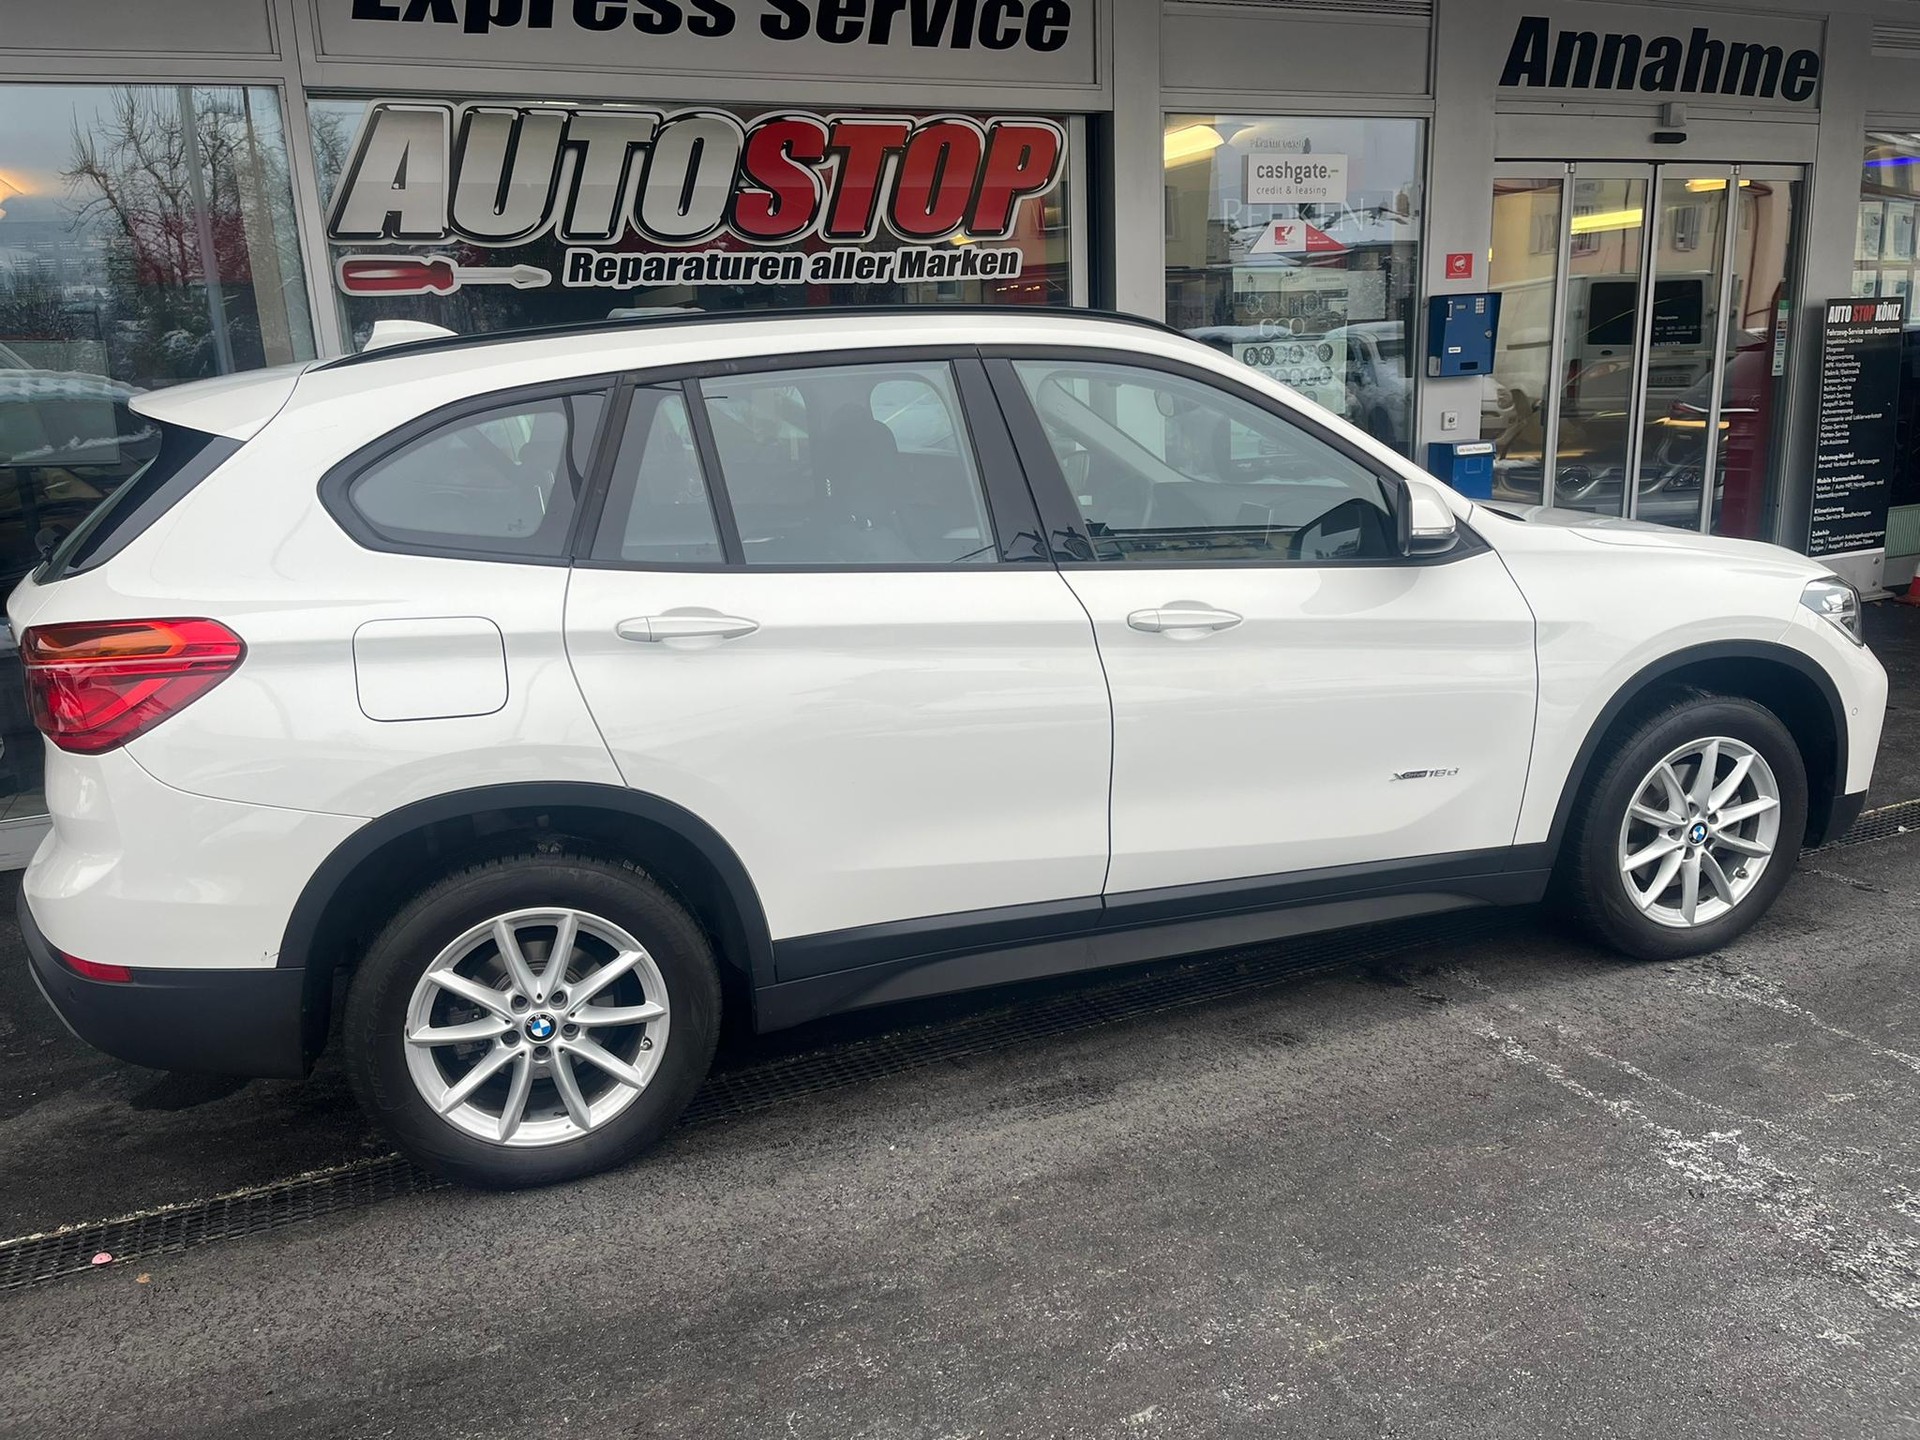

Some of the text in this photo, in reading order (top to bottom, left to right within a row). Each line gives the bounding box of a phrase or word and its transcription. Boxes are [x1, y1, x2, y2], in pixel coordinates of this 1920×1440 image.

[351, 0, 1072, 52] pess Service
[1498, 16, 1820, 102] Annahme
[1256, 185, 1327, 196] credit & leasing
[568, 250, 1019, 283] Reparaturen aller Marken
[1828, 301, 1901, 323] AUTO STOP KÖNIZ
